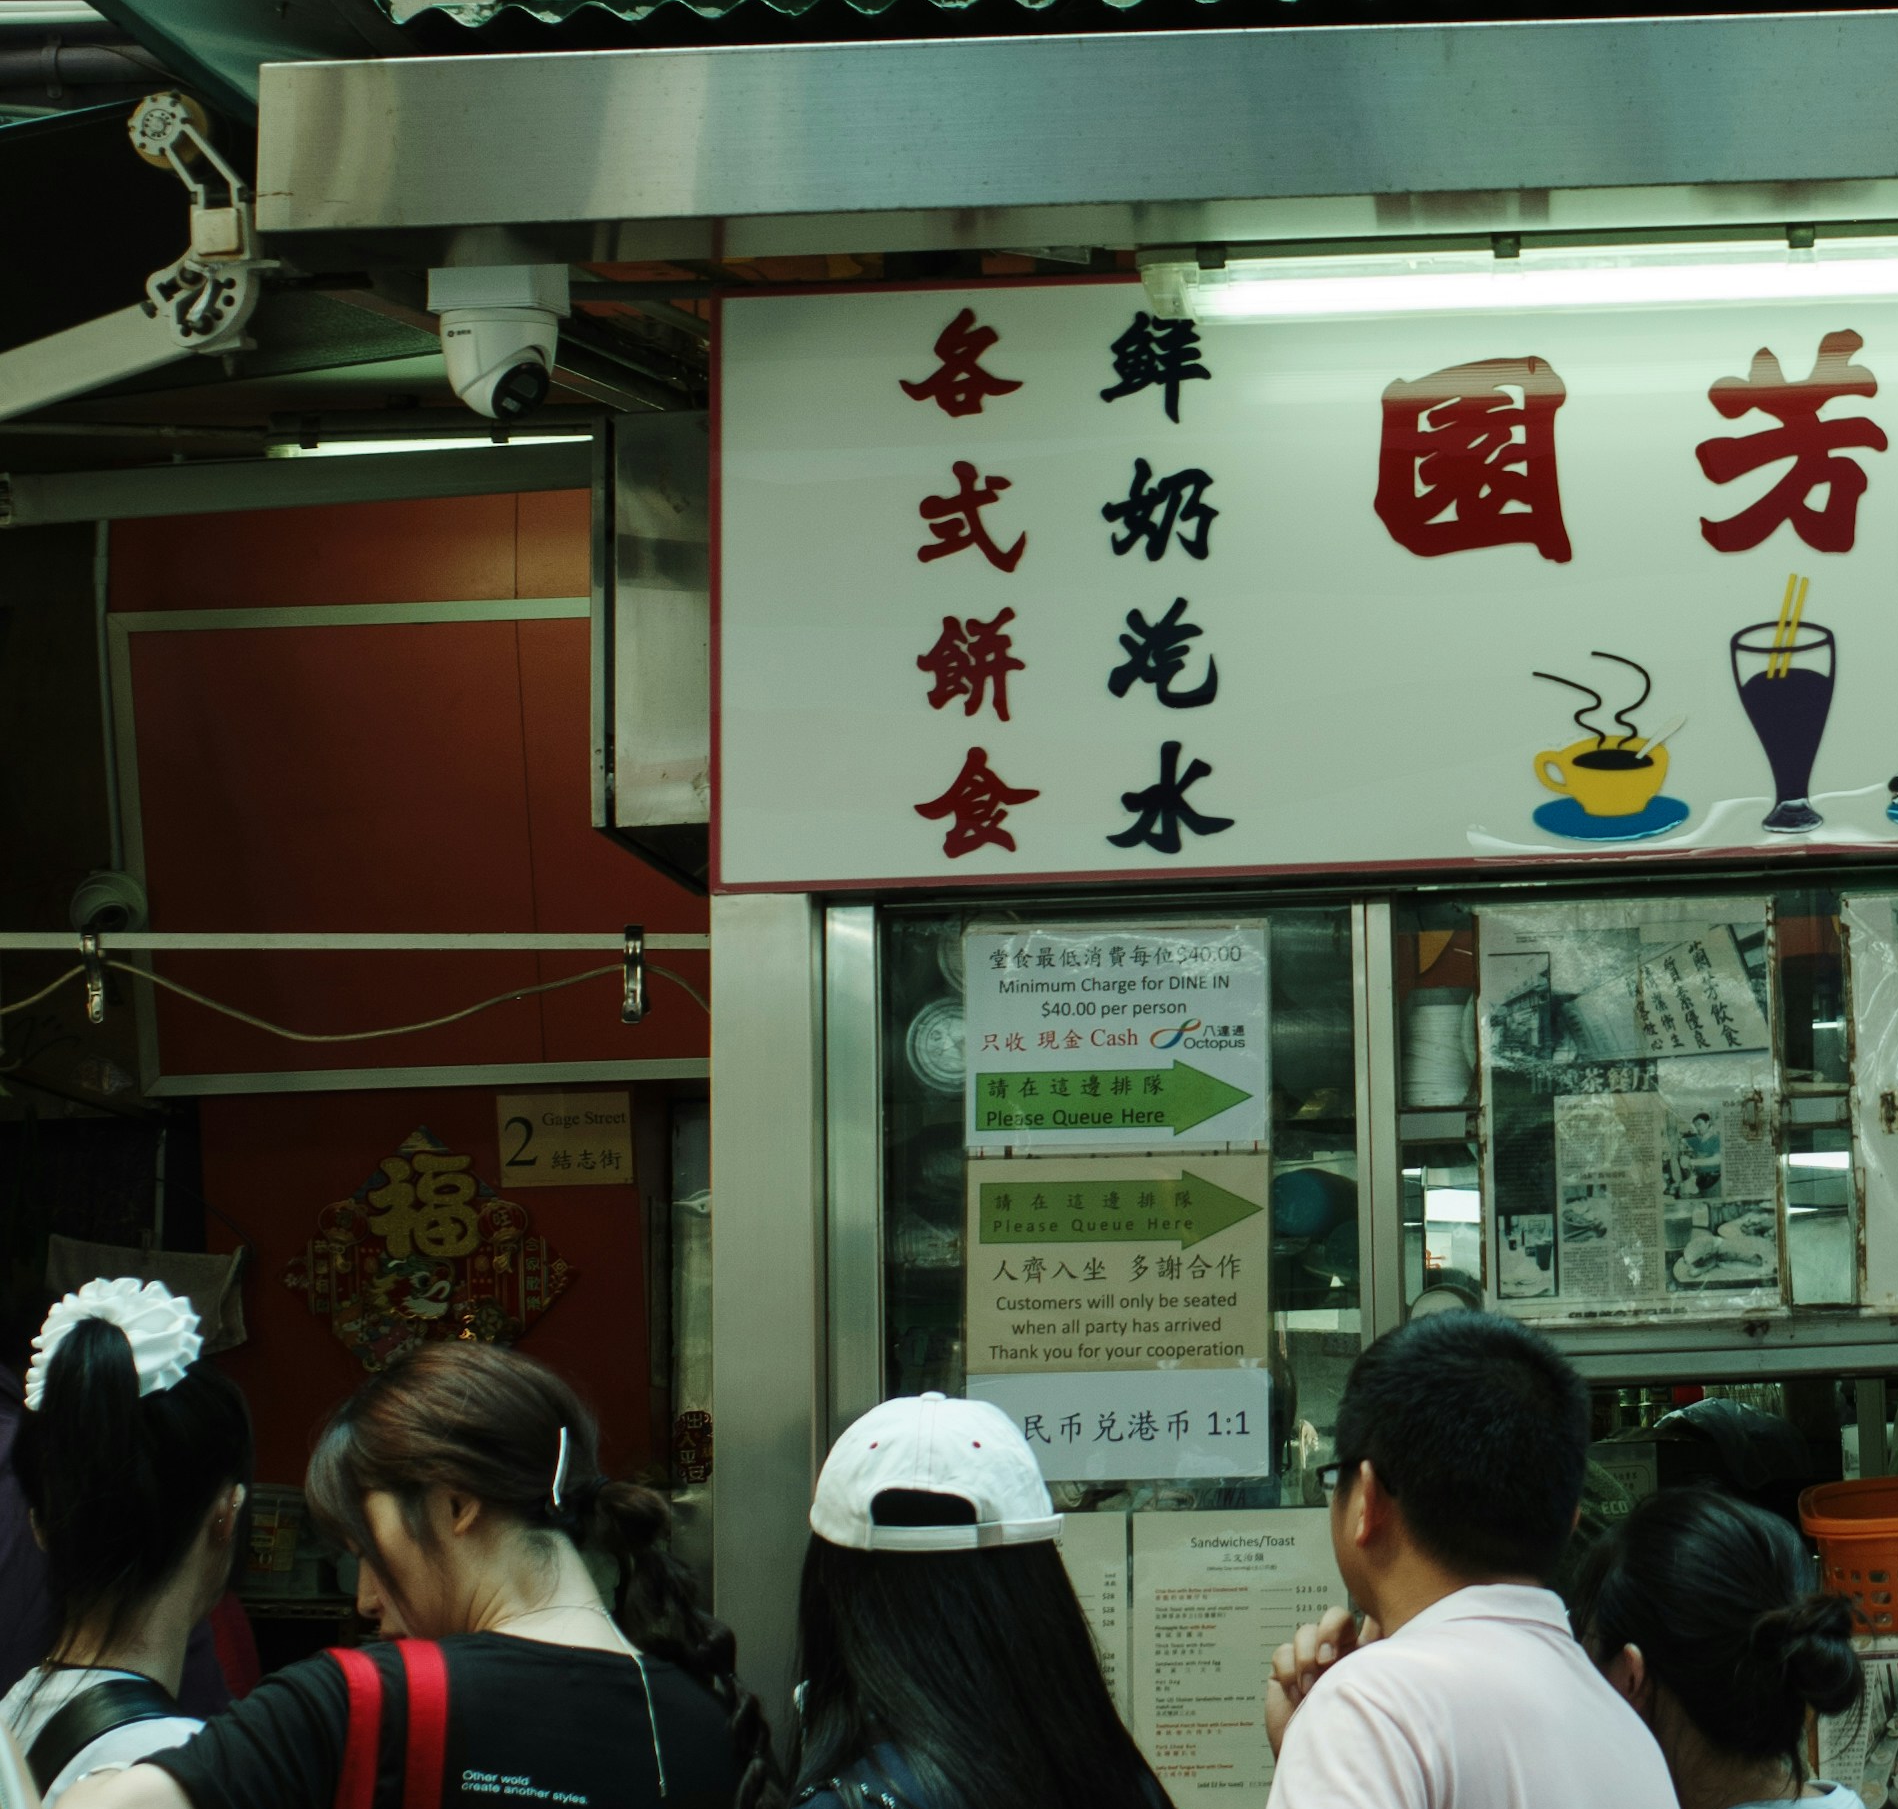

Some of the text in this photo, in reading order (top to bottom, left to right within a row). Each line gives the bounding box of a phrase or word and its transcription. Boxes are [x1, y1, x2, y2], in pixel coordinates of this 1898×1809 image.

[899, 308, 1040, 859] 各式餅食
[999, 974, 1231, 996] Minimum Charge for DINE IN
[1041, 1000, 1187, 1020] $40.00 per person
[981, 1027, 1139, 1053] 只收 現金 Cash
[1202, 1024, 1246, 1038] 八達通
[1183, 1036, 1246, 1052] Octopus
[986, 1074, 1165, 1099] 請在這邊排隊
[541, 1111, 627, 1129] Gage Street
[986, 1107, 1165, 1128] Please Queue Here
[504, 1116, 538, 1167] 2
[551, 1149, 623, 1171] 結志街
[368, 1151, 480, 1259] 福
[993, 1216, 1194, 1235] Please Queue Here
[992, 1253, 1243, 1284] 人齊入坐 多謝合作
[996, 1292, 1238, 1313] Customers will only be seated
[1011, 1316, 1222, 1338] when all party has arrived
[989, 1340, 1245, 1362] Thank you for your cooperation
[1207, 1410, 1251, 1437] 1:1
[1190, 1535, 1295, 1551] Sandwiches/Toast
[462, 1770, 498, 1782] Other
[461, 1782, 501, 1793] create
[503, 1785, 551, 1799] another
